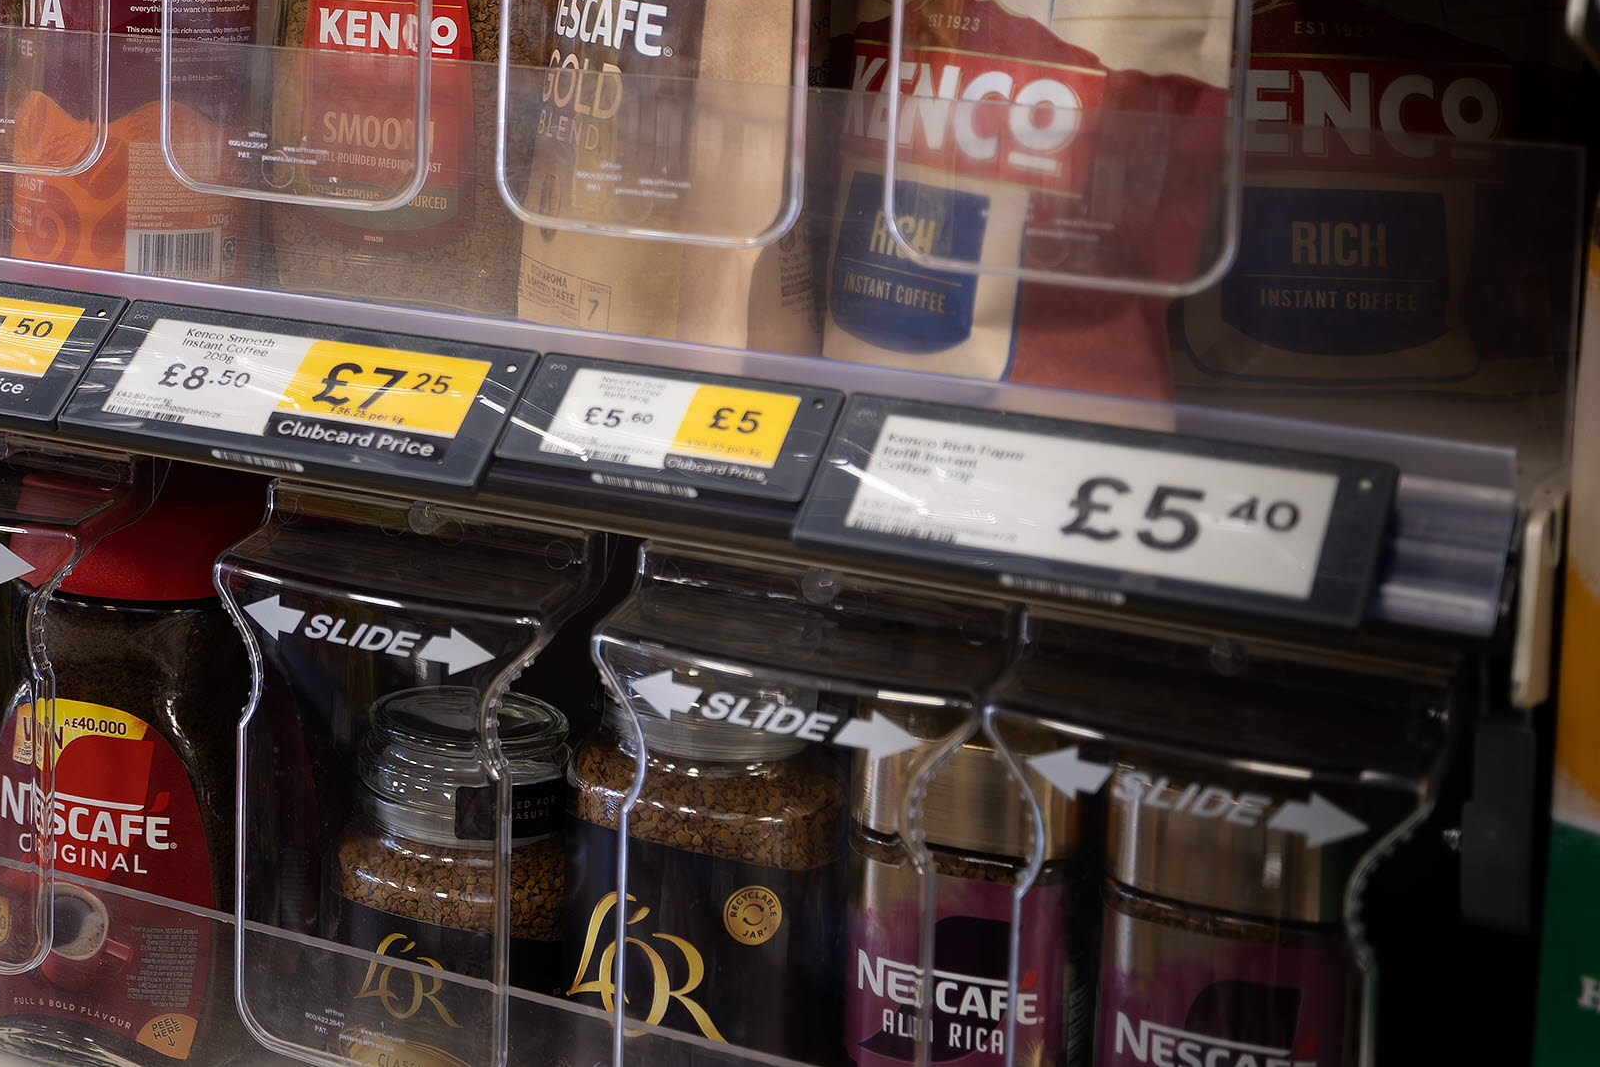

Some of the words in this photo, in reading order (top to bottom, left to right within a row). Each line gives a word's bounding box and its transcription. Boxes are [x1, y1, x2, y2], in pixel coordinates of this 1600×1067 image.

[1294, 20, 1328, 36] EST
[847, 54, 1082, 161] KENCO
[537, 109, 600, 151] BLEND
[1292, 222, 1387, 266] RICH
[843, 272, 894, 302] INSTANT
[896, 283, 946, 314] COFFEE
[1259, 287, 1339, 310] INSTANT
[1345, 289, 1418, 311] COFFEE
[182, 337, 224, 352] Instant
[225, 343, 269, 358] Coffee
[186, 327, 225, 341] Kenco
[227, 333, 275, 348] Smooth
[203, 351, 234, 364] 200g
[158, 362, 251, 391] £8.50
[311, 361, 454, 410] £7.25
[330, 405, 366, 419] £36.25
[367, 412, 391, 423] per
[392, 415, 403, 425] kg
[583, 406, 654, 428] £5.60
[708, 407, 763, 434] £5
[277, 419, 375, 448] Clubcard
[377, 432, 435, 458] Price
[887, 433, 940, 452] Kenco
[942, 439, 977, 456] Rich
[980, 444, 1025, 462] Paper
[665, 456, 727, 475] Clubcard
[728, 466, 766, 481] Price
[883, 447, 922, 461] Refill
[924, 452, 978, 468] Instant
[1059, 476, 1301, 553] £5.40
[304, 614, 422, 658] SLIDE
[64, 718, 71, 728] A
[71, 717, 127, 735] £40,000
[701, 691, 839, 742] SLIDE
[1112, 771, 1273, 827] SLIDE
[729, 891, 777, 919] RECYCLABLE
[13, 997, 35, 1008] FULL
[48, 1000, 76, 1013] BOLD
[80, 1006, 132, 1030] FLAVOUR
[151, 1018, 178, 1032] PEEL
[153, 1023, 182, 1041] HERE
[949, 1023, 1005, 1055] RICA
